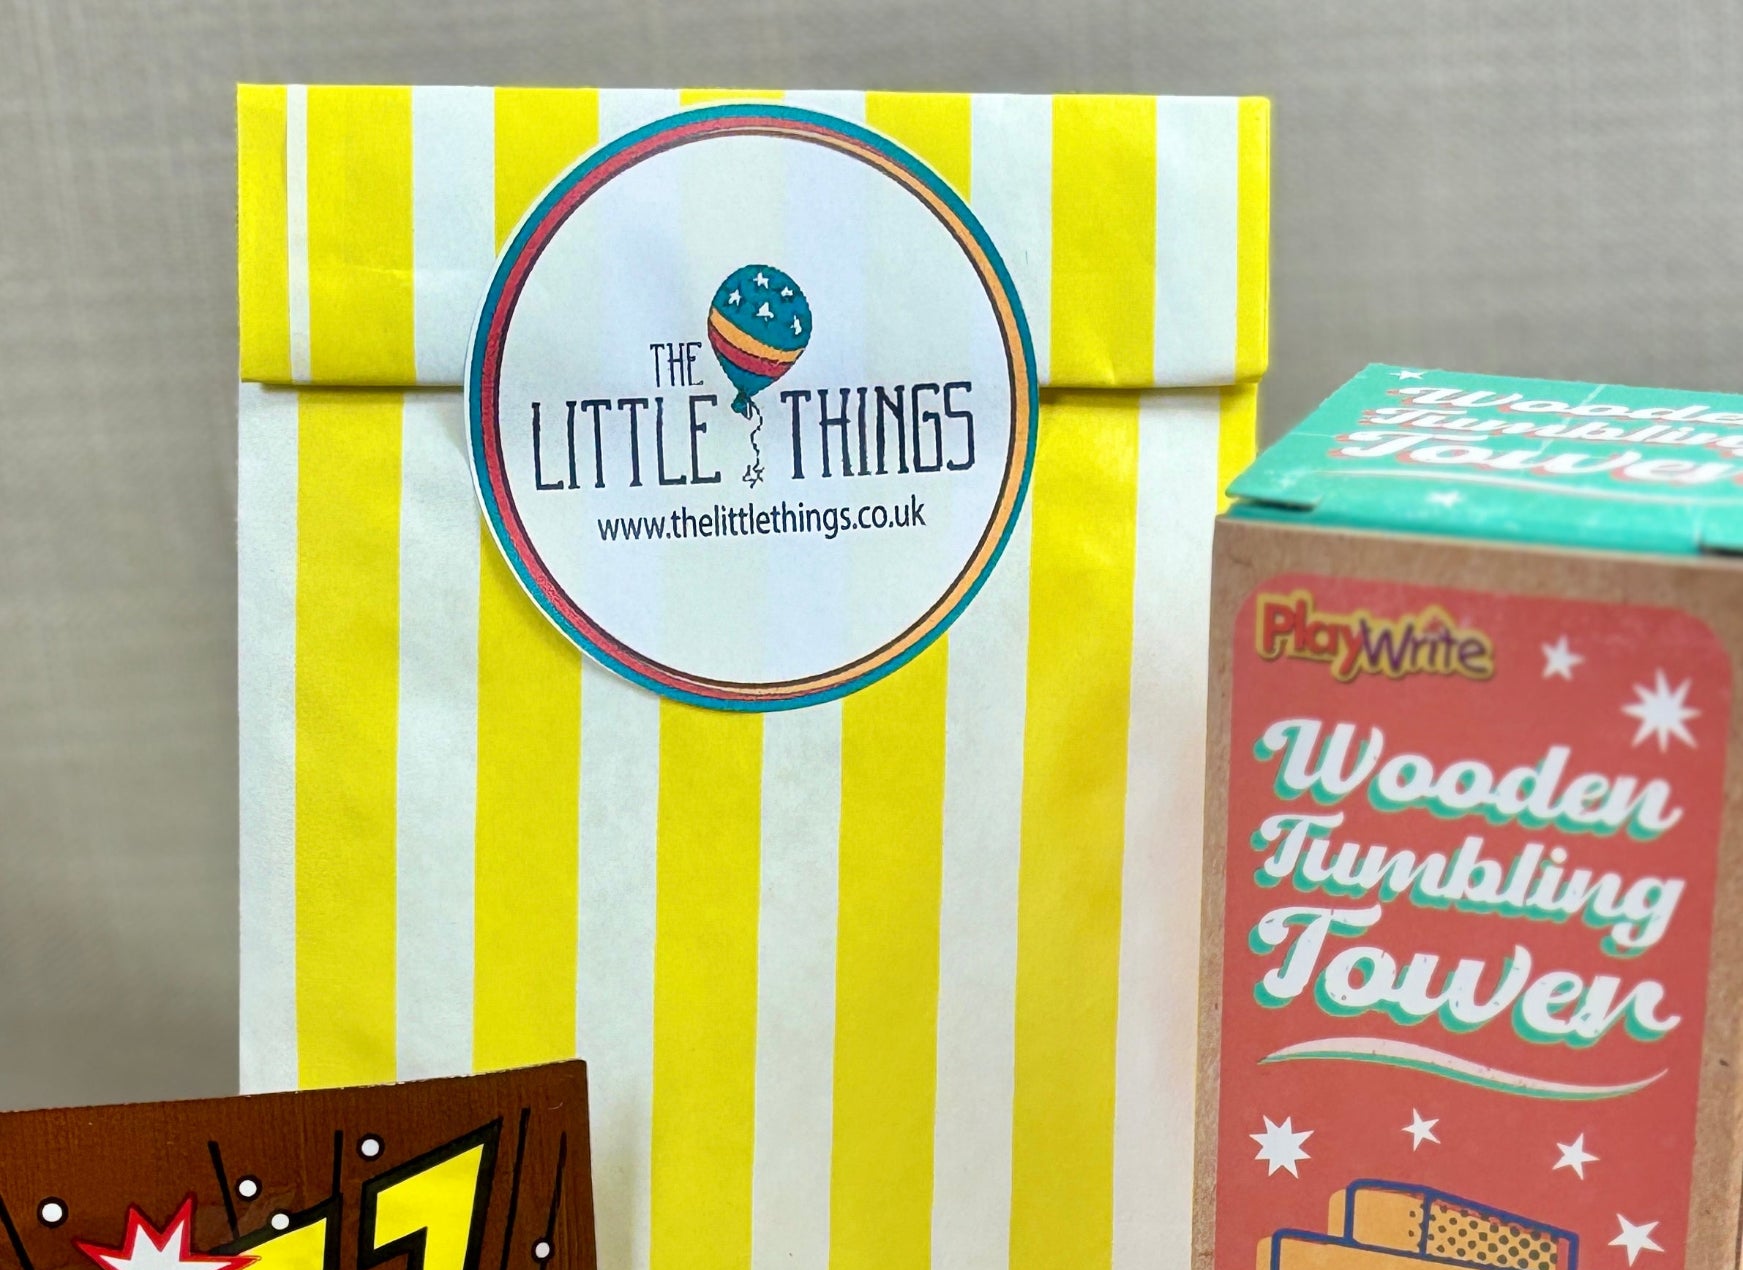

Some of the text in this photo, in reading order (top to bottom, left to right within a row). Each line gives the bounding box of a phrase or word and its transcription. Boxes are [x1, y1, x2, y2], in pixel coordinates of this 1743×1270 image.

[650, 341, 704, 387] THE
[1388, 386, 1743, 426] Woode
[531, 381, 976, 491] LITTLE THINGS
[597, 494, 926, 541] www.thelittlethings.co.uk
[1254, 718, 1683, 839] Wooden
[1251, 811, 1685, 957] Tumbling
[1249, 903, 1682, 1047] Tower
